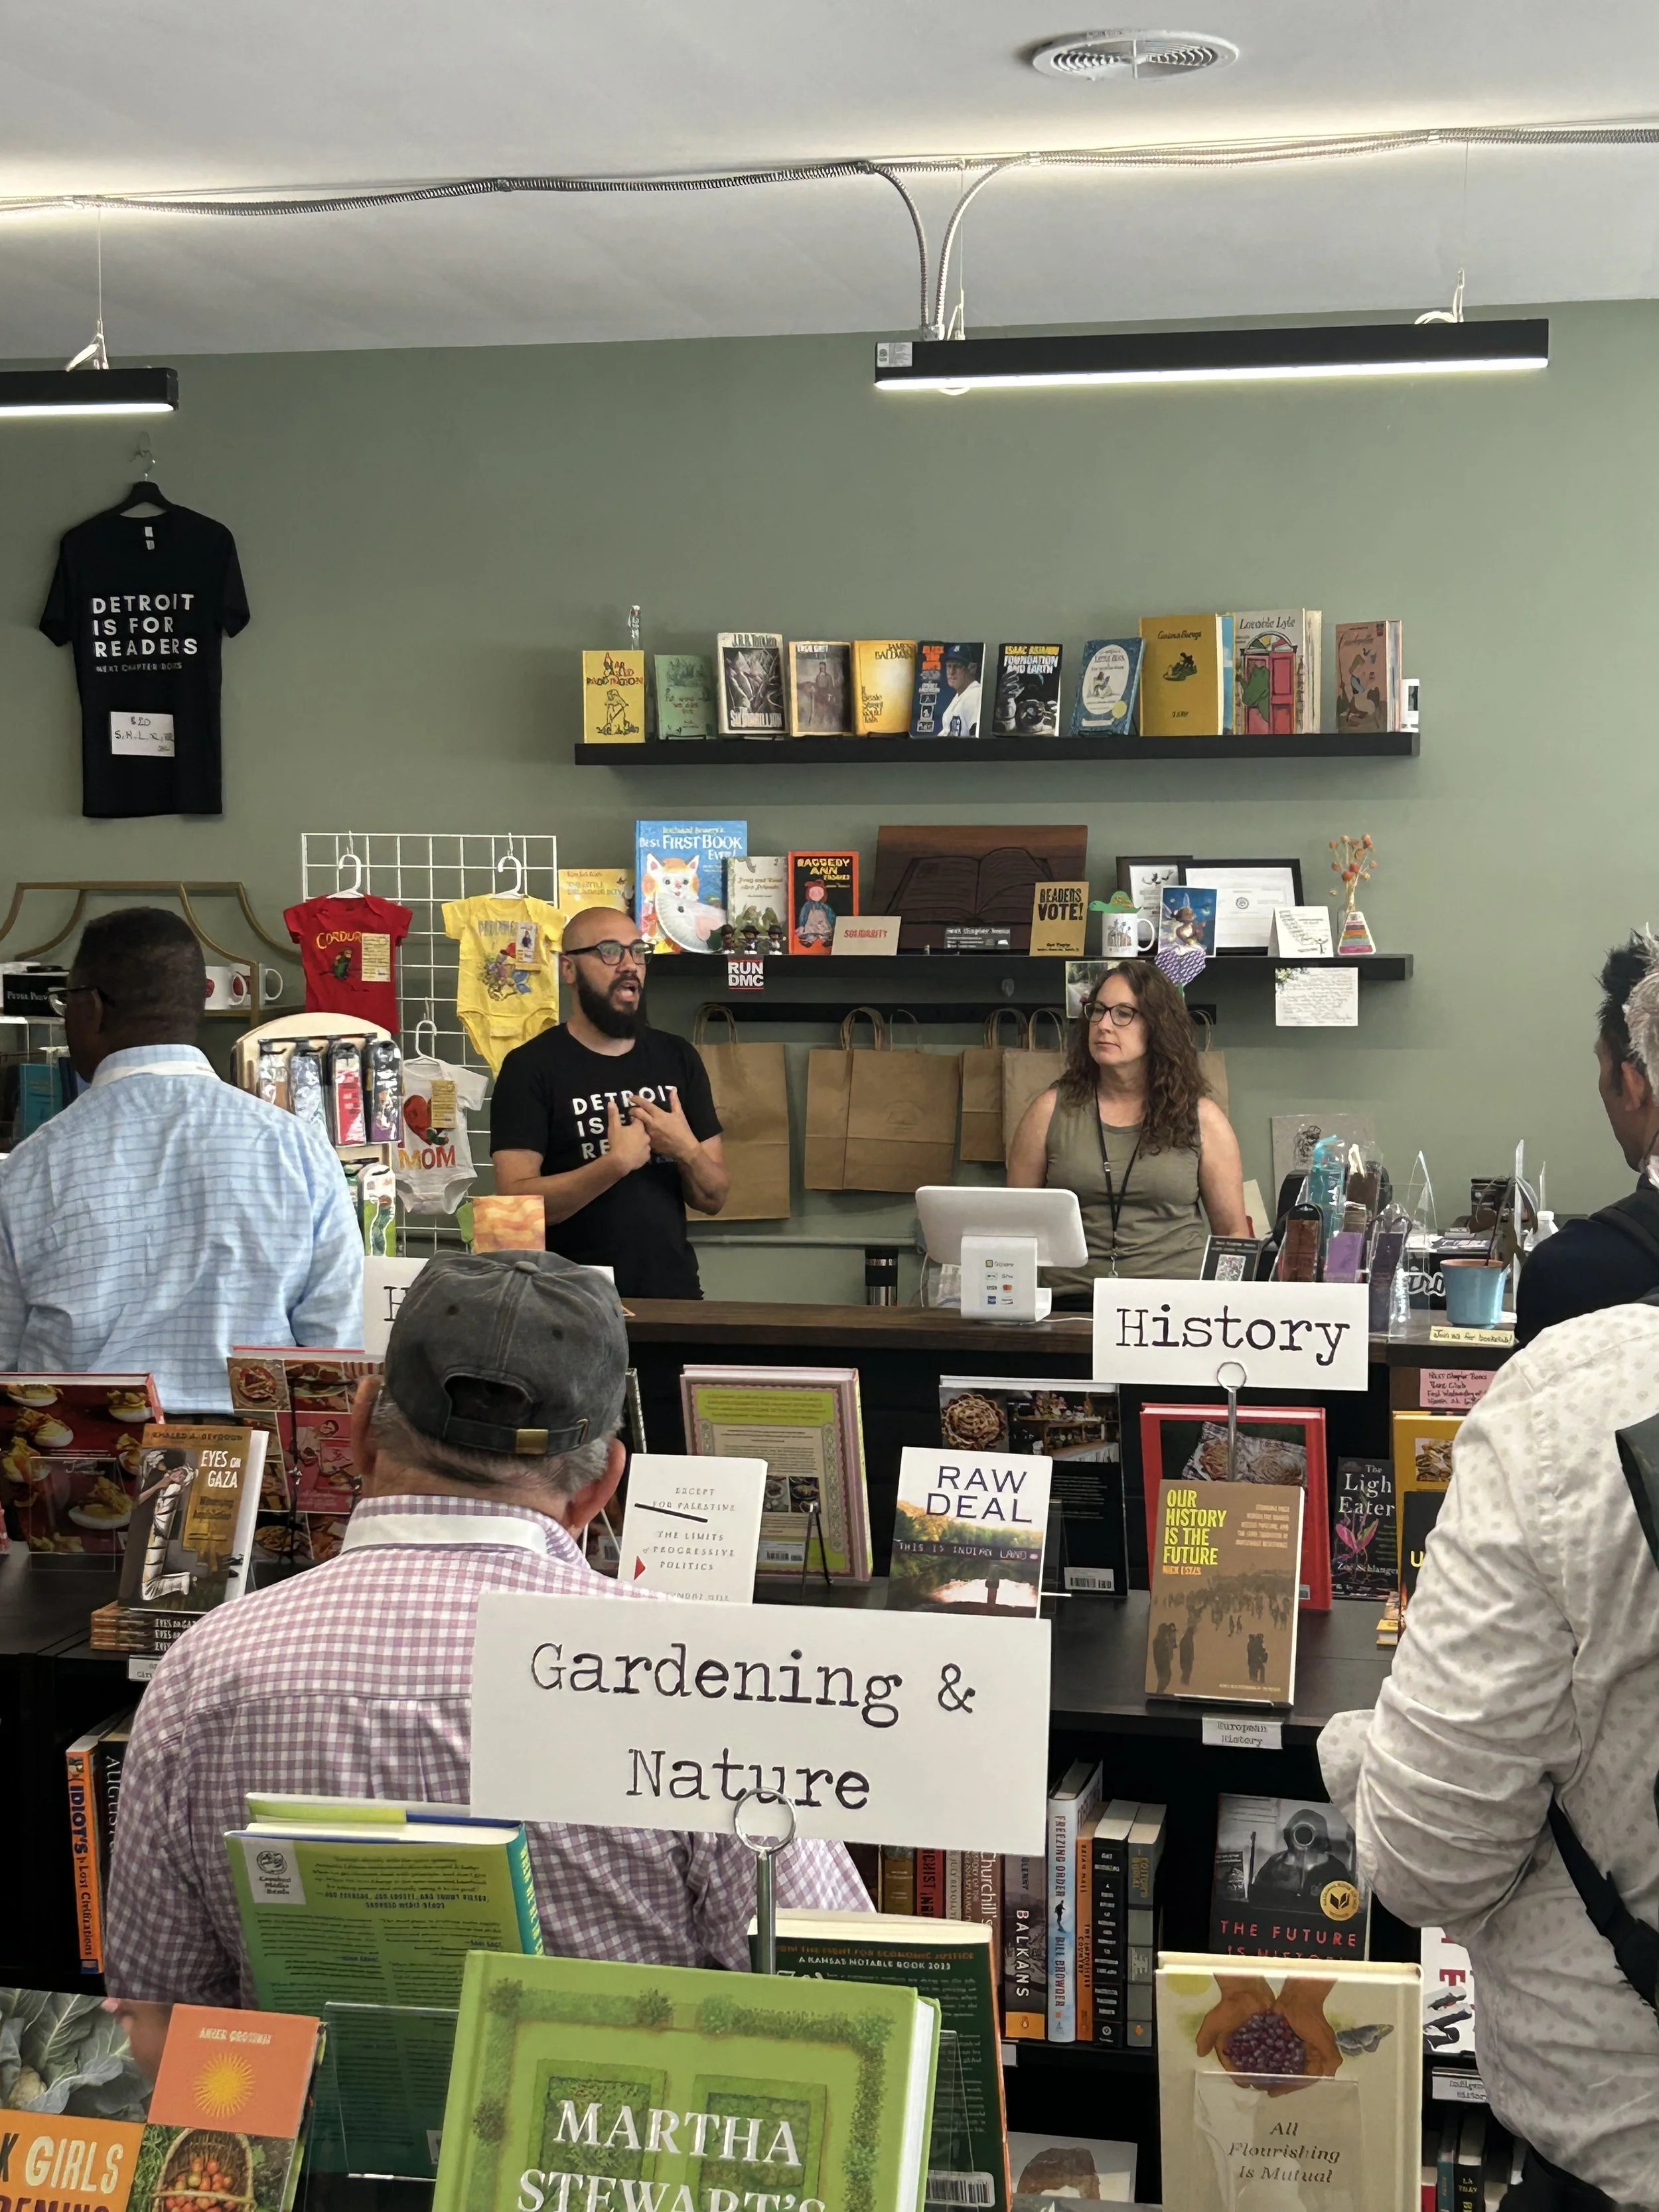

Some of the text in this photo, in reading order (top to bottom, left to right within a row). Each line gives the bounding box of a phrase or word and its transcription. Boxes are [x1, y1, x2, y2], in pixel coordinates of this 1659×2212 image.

[92, 594, 194, 614] DETROIT
[93, 616, 173, 636] IS FOR
[94, 638, 198, 657] READERS
[663, 834, 701, 849] FIRST
[702, 834, 743, 849] BOOK
[797, 858, 850, 867] RAGGEDY
[1039, 888, 1082, 903] READERS
[1038, 903, 1084, 921] VOTE!
[728, 961, 763, 974] RUN
[729, 974, 764, 988] DMC
[576, 1116, 605, 1138] IS
[399, 1145, 457, 1171] MOM
[1115, 1303, 1351, 1367] History
[1433, 1329, 1449, 1339] Join
[200, 1450, 228, 1468] EYES
[1365, 1464, 1383, 1473] The
[208, 1470, 238, 1489] GAZA
[936, 1465, 1029, 1494] RAW
[1344, 1473, 1392, 1499] Ligh
[678, 1502, 736, 1512] PALESTINE
[926, 1493, 1033, 1524] DEAL
[1167, 1489, 1198, 1508] OUR
[1338, 1496, 1396, 1517] Eater
[1165, 1508, 1227, 1528] HISTORY
[657, 1530, 724, 1541] THE LIMITS
[1165, 1526, 1210, 1546] IS THE
[899, 1542, 924, 1552] THIS
[953, 1546, 993, 1556] INDIAN
[999, 1549, 1027, 1560] LAND
[1163, 1546, 1218, 1566] FUTURE
[660, 1561, 714, 1571] POLITICS
[531, 1643, 977, 1729] Gardening &
[625, 1747, 870, 1811] Nature
[1054, 1815, 1066, 1897] FREEZING ORDER
[1220, 1919, 1357, 1947] THE FUTURE
[808, 1956, 847, 1965] KANSAS
[849, 1958, 894, 1968] NOTABLE
[1015, 1909, 1029, 1998] BALKANS
[1055, 1937, 1066, 2006] BILL BROWDER
[552, 2099, 802, 2167] MARTHA
[1269, 2122, 1299, 2136] All
[1228, 2142, 1340, 2164] Flourishing
[25, 2135, 124, 2194] GIRLS
[1239, 2166, 1333, 2183] Is Mutual
